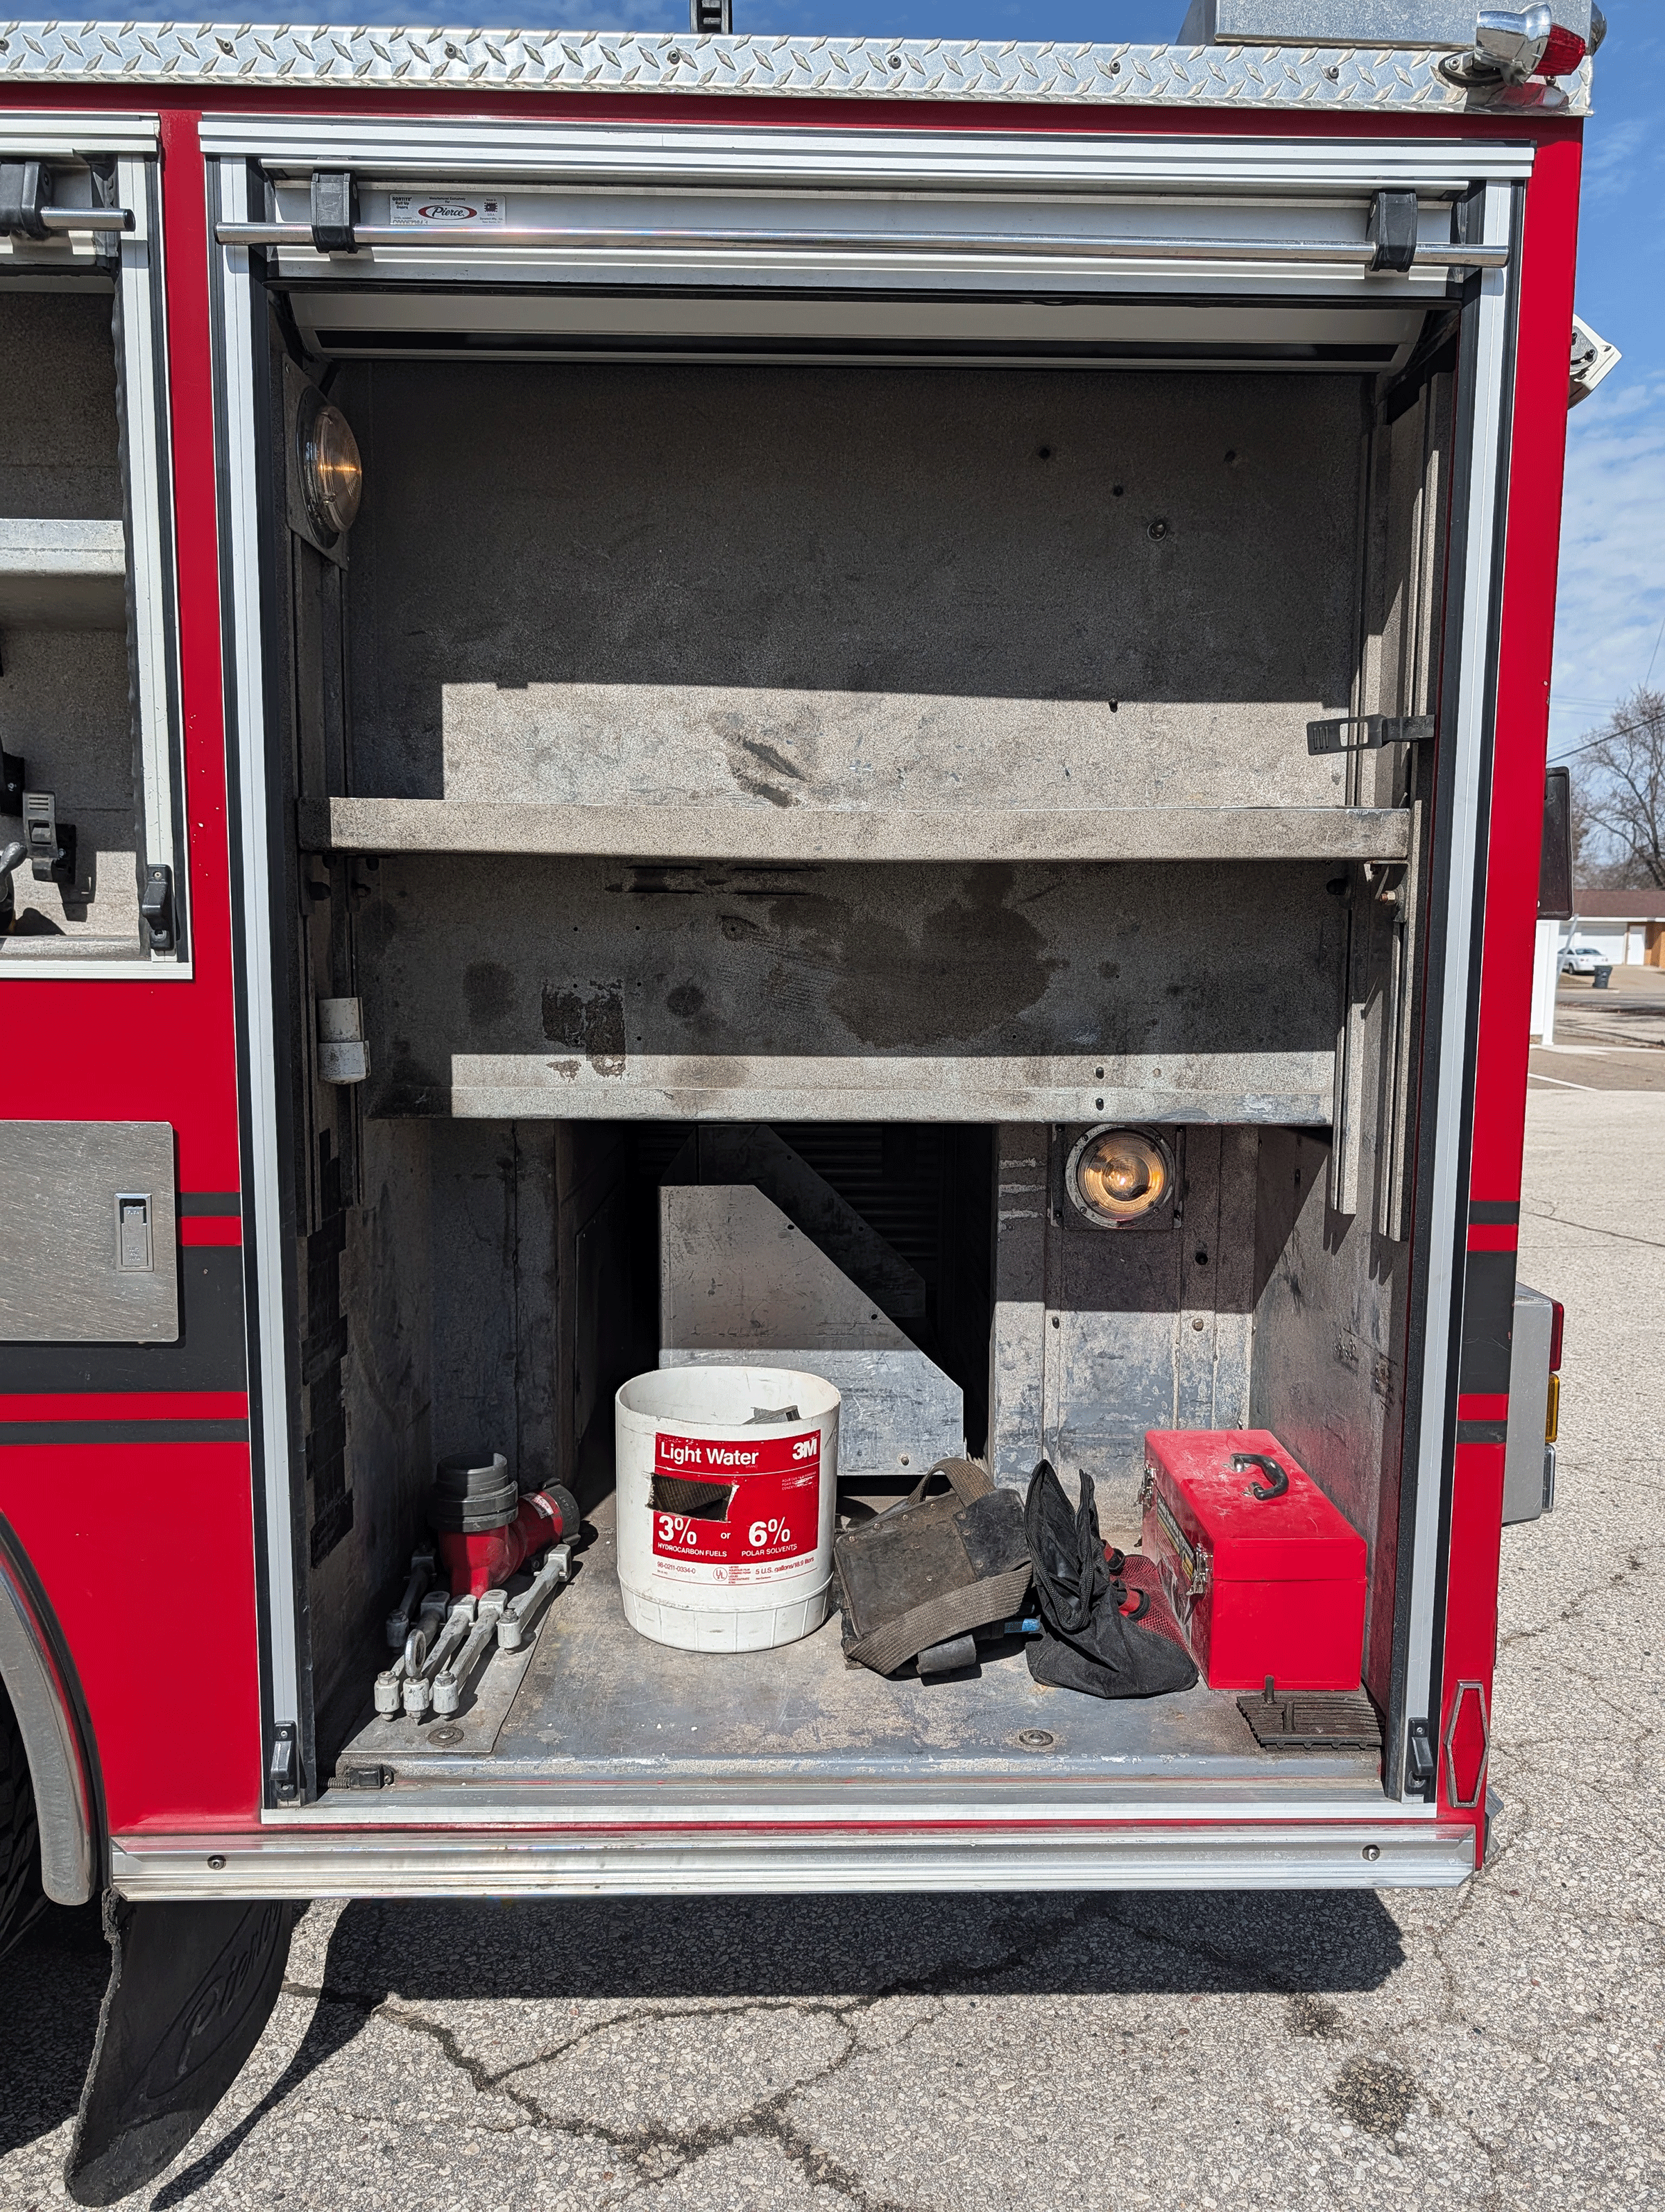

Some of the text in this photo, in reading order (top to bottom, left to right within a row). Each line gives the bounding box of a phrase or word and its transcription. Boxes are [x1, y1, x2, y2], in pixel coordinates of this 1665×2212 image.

[432, 206, 464, 216] Pierce
[661, 1441, 759, 1465] Light Water
[792, 1438, 817, 1460] 3M
[658, 1515, 697, 1545] 3%
[749, 1517, 790, 1547] 6%
[658, 1542, 704, 1556] HYDROCARBON
[766, 1544, 797, 1554] SOLVENTS
[657, 1561, 696, 1574] 98-0211-0334-0
